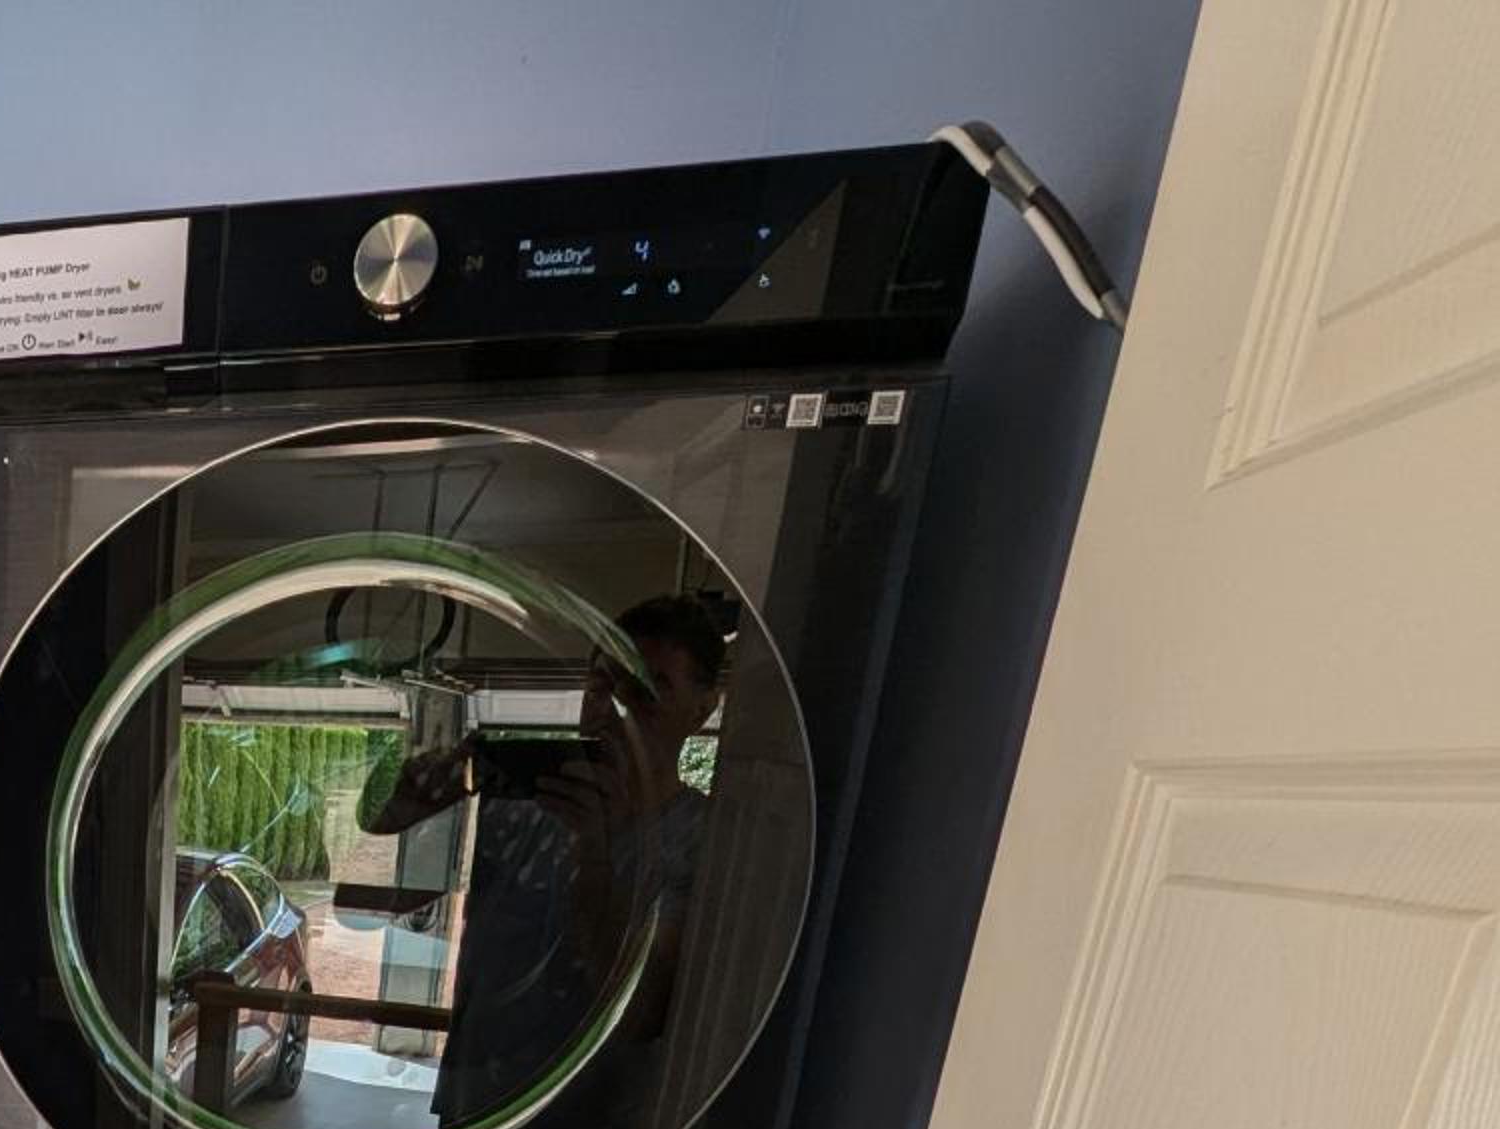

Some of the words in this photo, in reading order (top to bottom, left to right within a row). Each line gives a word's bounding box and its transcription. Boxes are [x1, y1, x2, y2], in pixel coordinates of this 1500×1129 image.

[533, 248, 564, 266] Quick
[8, 266, 34, 279] HEAT
[35, 263, 63, 276] PUMP
[64, 262, 90, 274] Dryer
[14, 292, 45, 305] friendly
[24, 312, 51, 324] Empty
[52, 308, 74, 321] LINT
